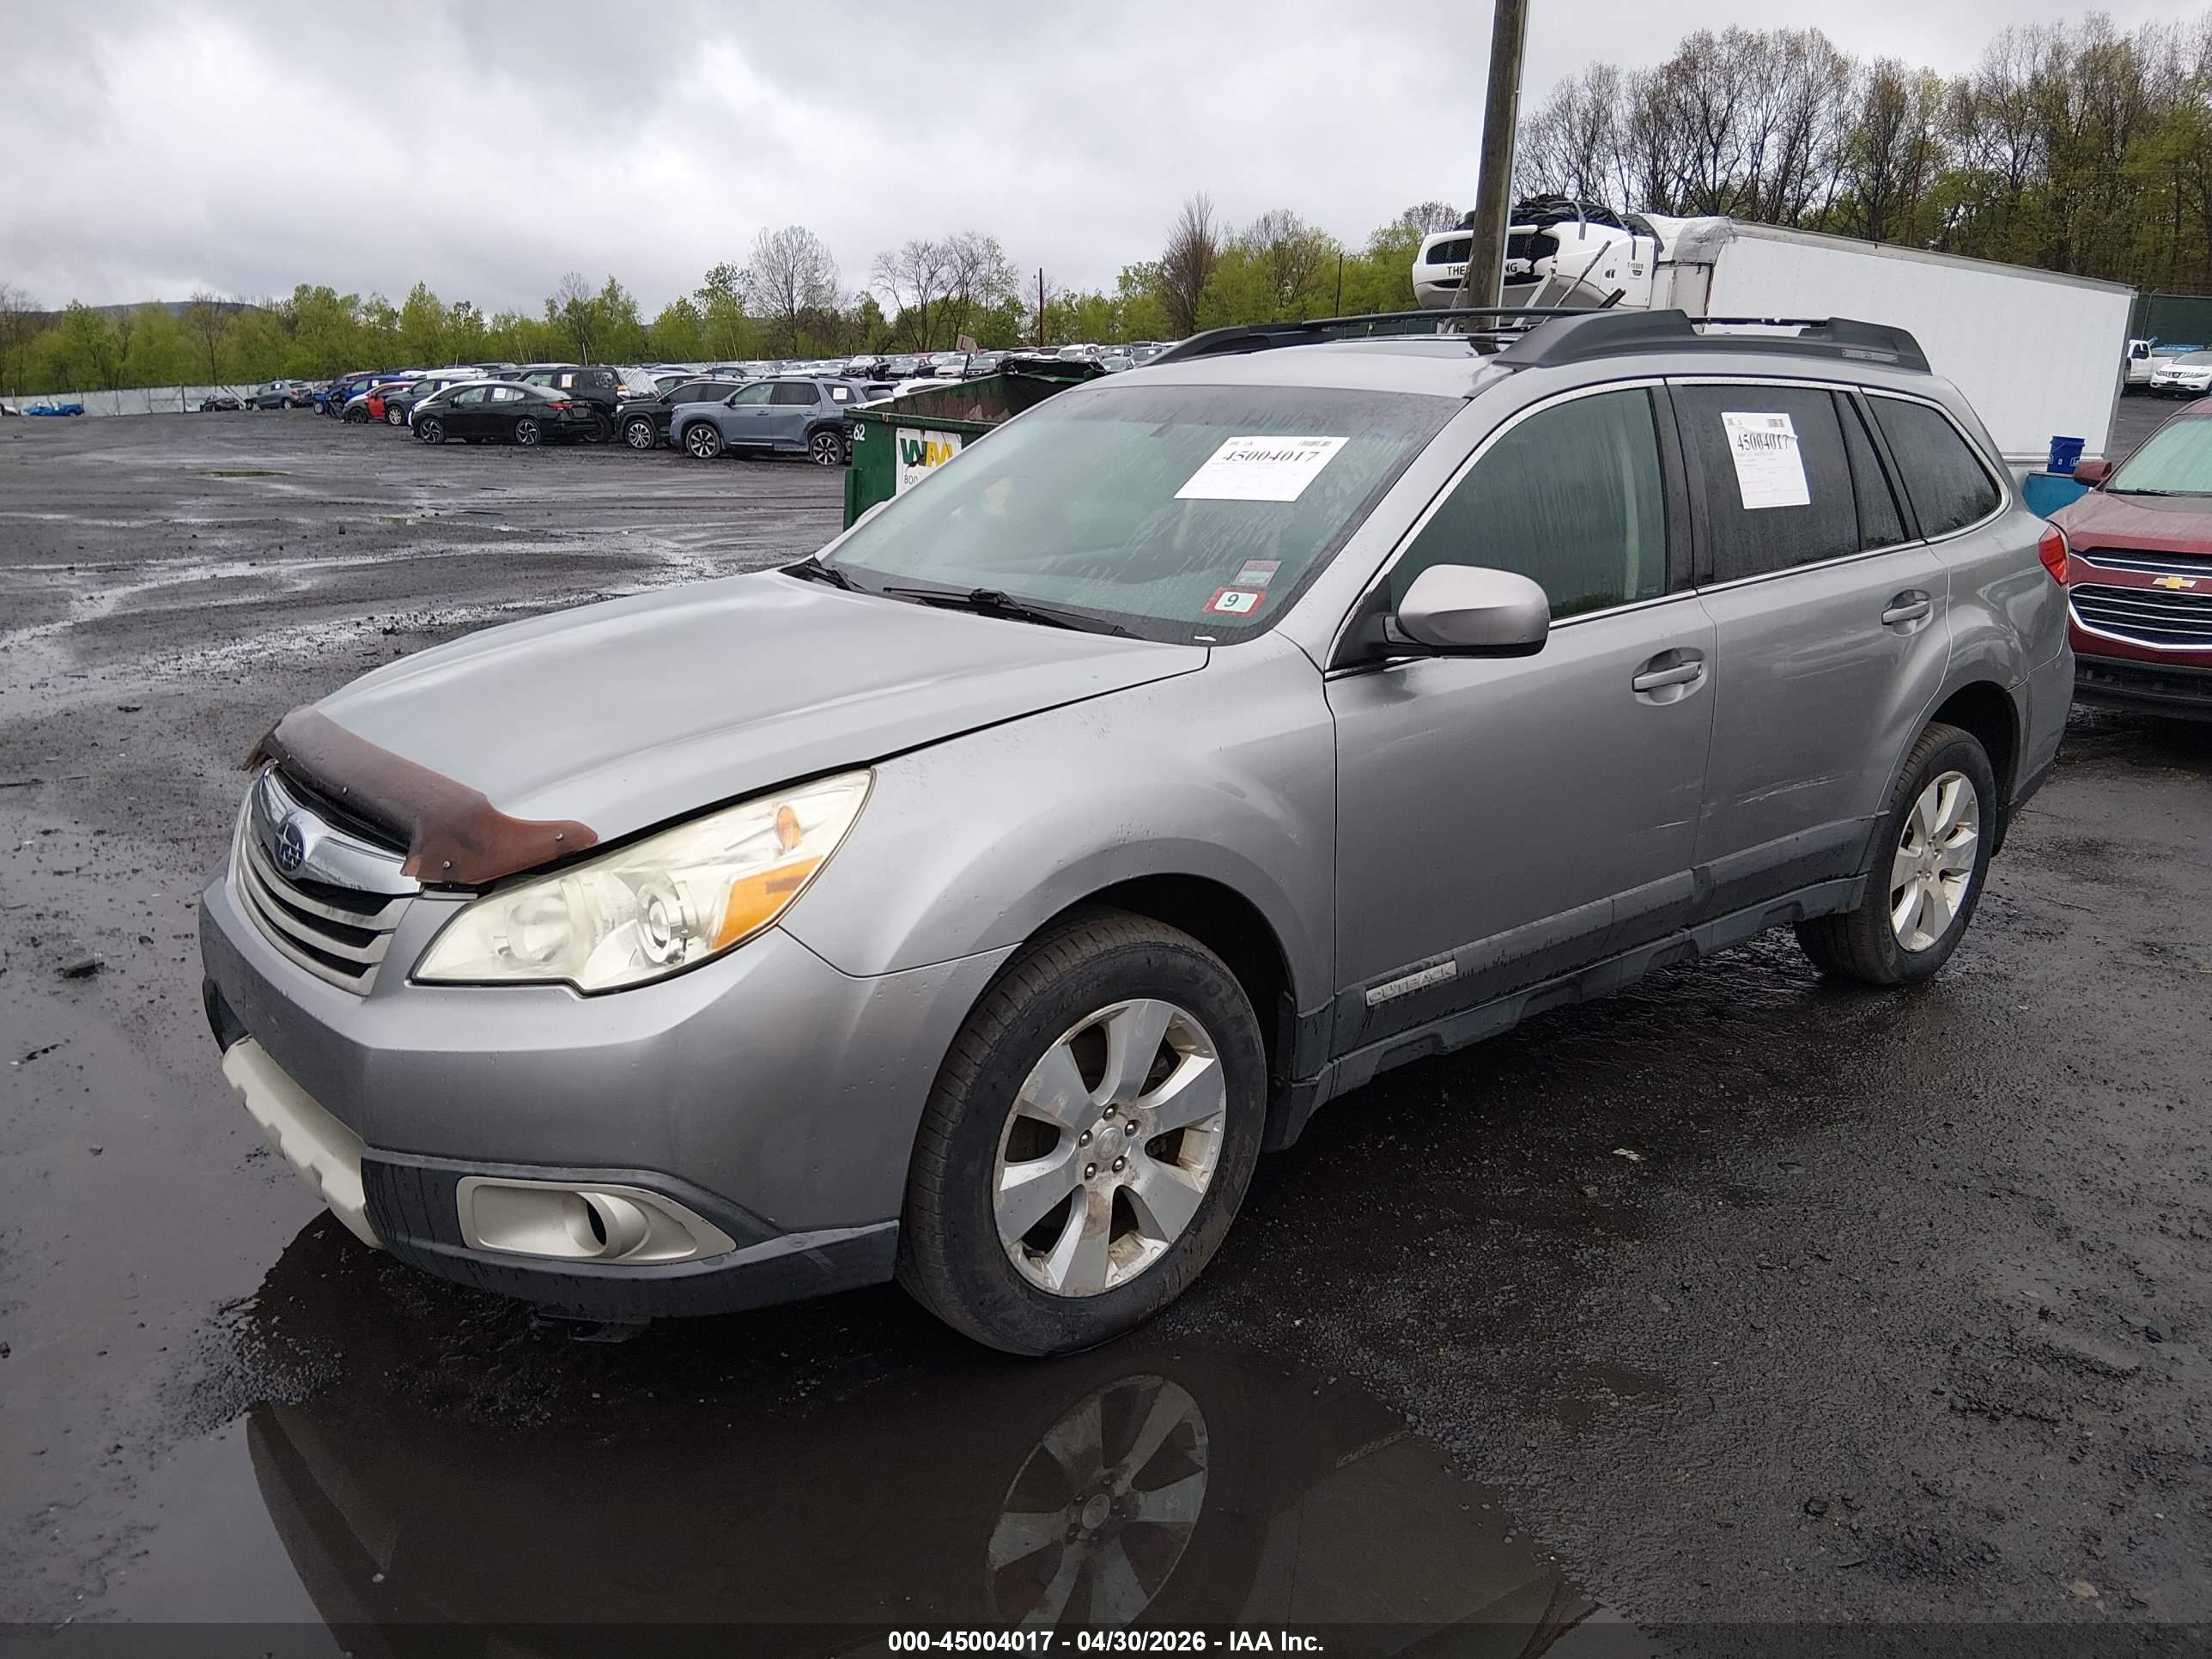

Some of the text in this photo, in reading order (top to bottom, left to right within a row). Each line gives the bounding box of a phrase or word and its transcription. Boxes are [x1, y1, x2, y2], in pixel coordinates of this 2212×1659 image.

[854, 423, 866, 441] 62
[1737, 432, 1789, 451] 45004017
[1223, 450, 1320, 462] 45004017
[1224, 593, 1239, 607] 9
